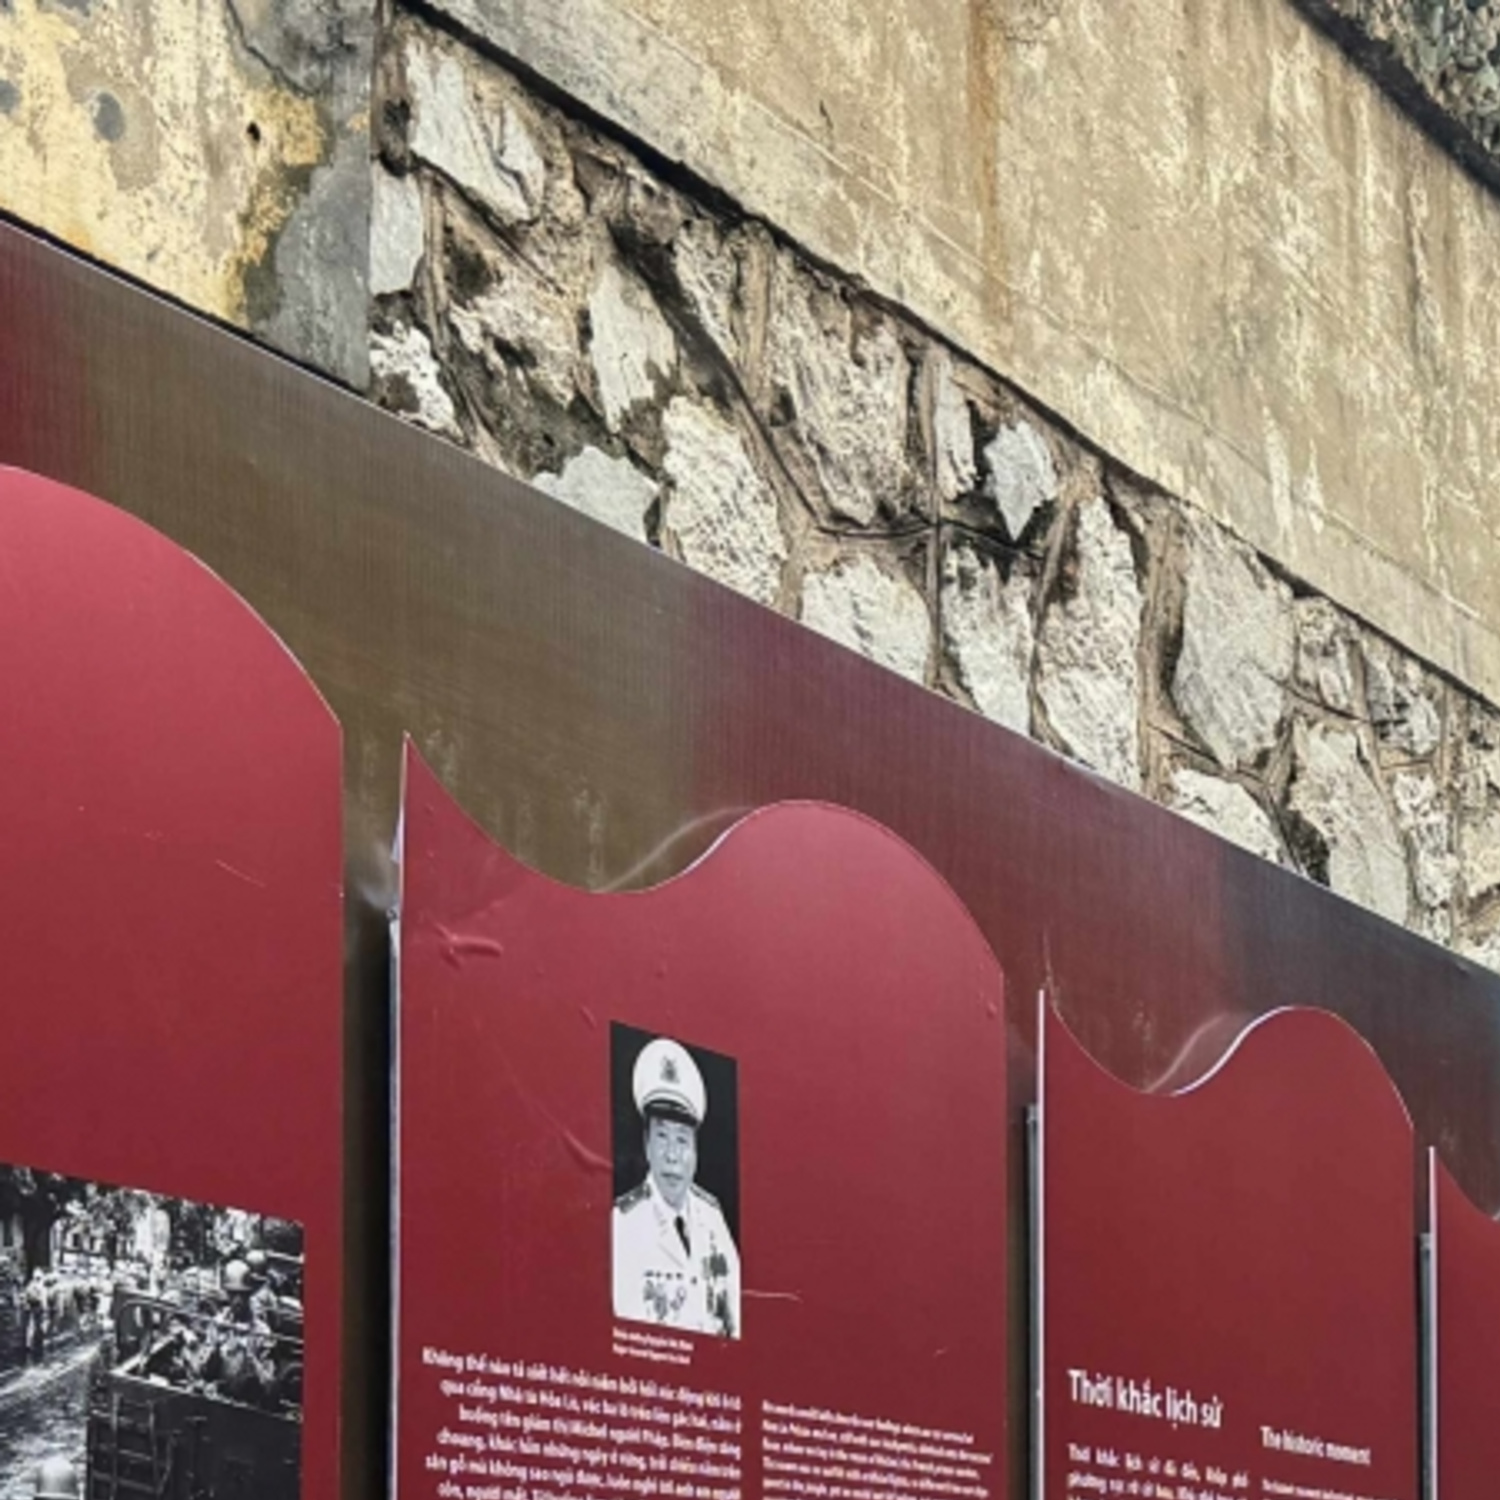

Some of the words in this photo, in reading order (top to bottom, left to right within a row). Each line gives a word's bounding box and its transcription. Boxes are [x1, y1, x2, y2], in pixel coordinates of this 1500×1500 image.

[1068, 1369, 1113, 1407] Thời
[1117, 1377, 1162, 1417] khắc
[1166, 1387, 1197, 1429] lịch
[1200, 1395, 1223, 1428] sử
